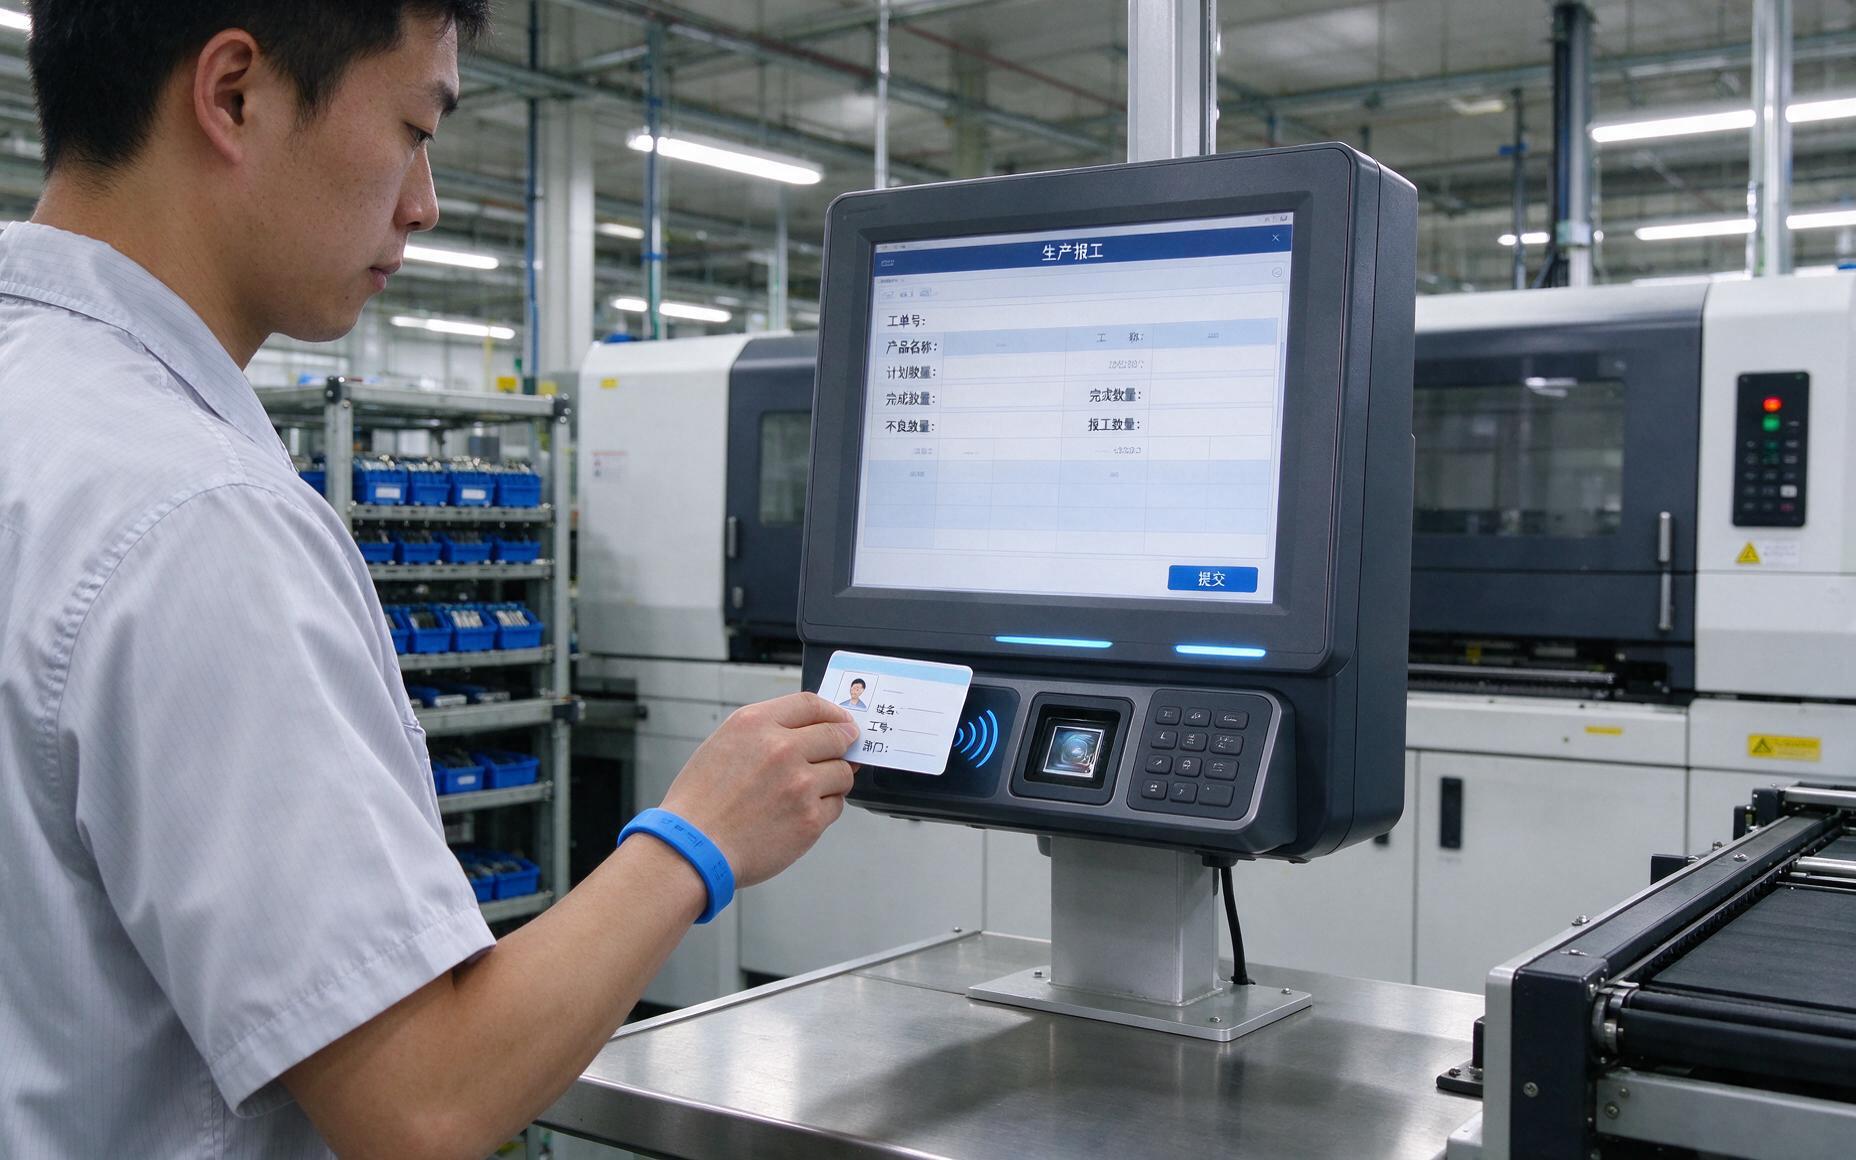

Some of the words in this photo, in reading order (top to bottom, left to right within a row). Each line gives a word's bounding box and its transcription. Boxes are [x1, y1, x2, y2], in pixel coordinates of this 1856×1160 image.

[1041, 242, 1104, 261] 生产报工
[886, 313, 926, 328] 工单号：
[886, 339, 938, 354] 产品名称：
[1198, 571, 1226, 586] 提交
